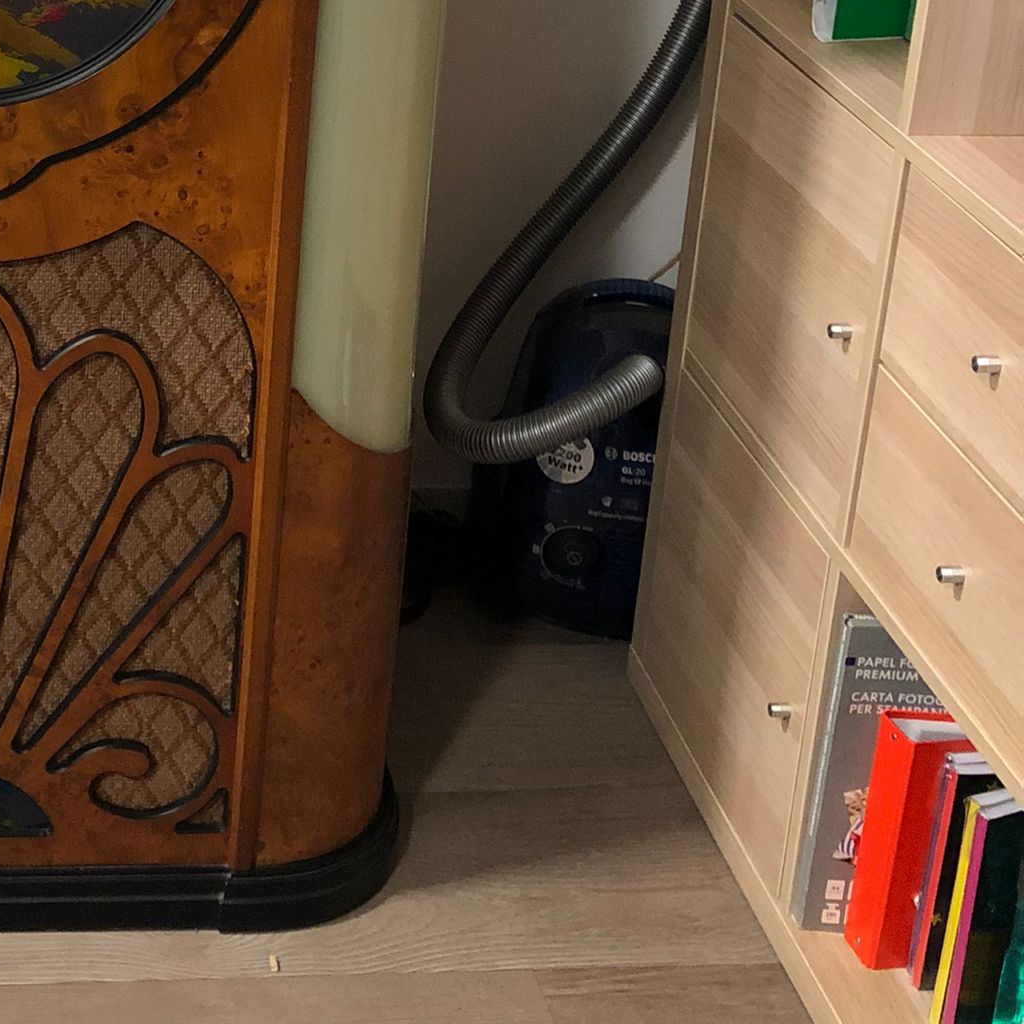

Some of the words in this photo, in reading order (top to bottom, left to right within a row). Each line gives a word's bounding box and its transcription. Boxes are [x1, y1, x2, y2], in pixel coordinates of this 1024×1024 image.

[622, 450, 655, 463] BOSC
[857, 656, 896, 668] PAPEL
[855, 669, 919, 681] PREMIUM
[851, 691, 894, 703] CARTA
[849, 704, 873, 714] PER
